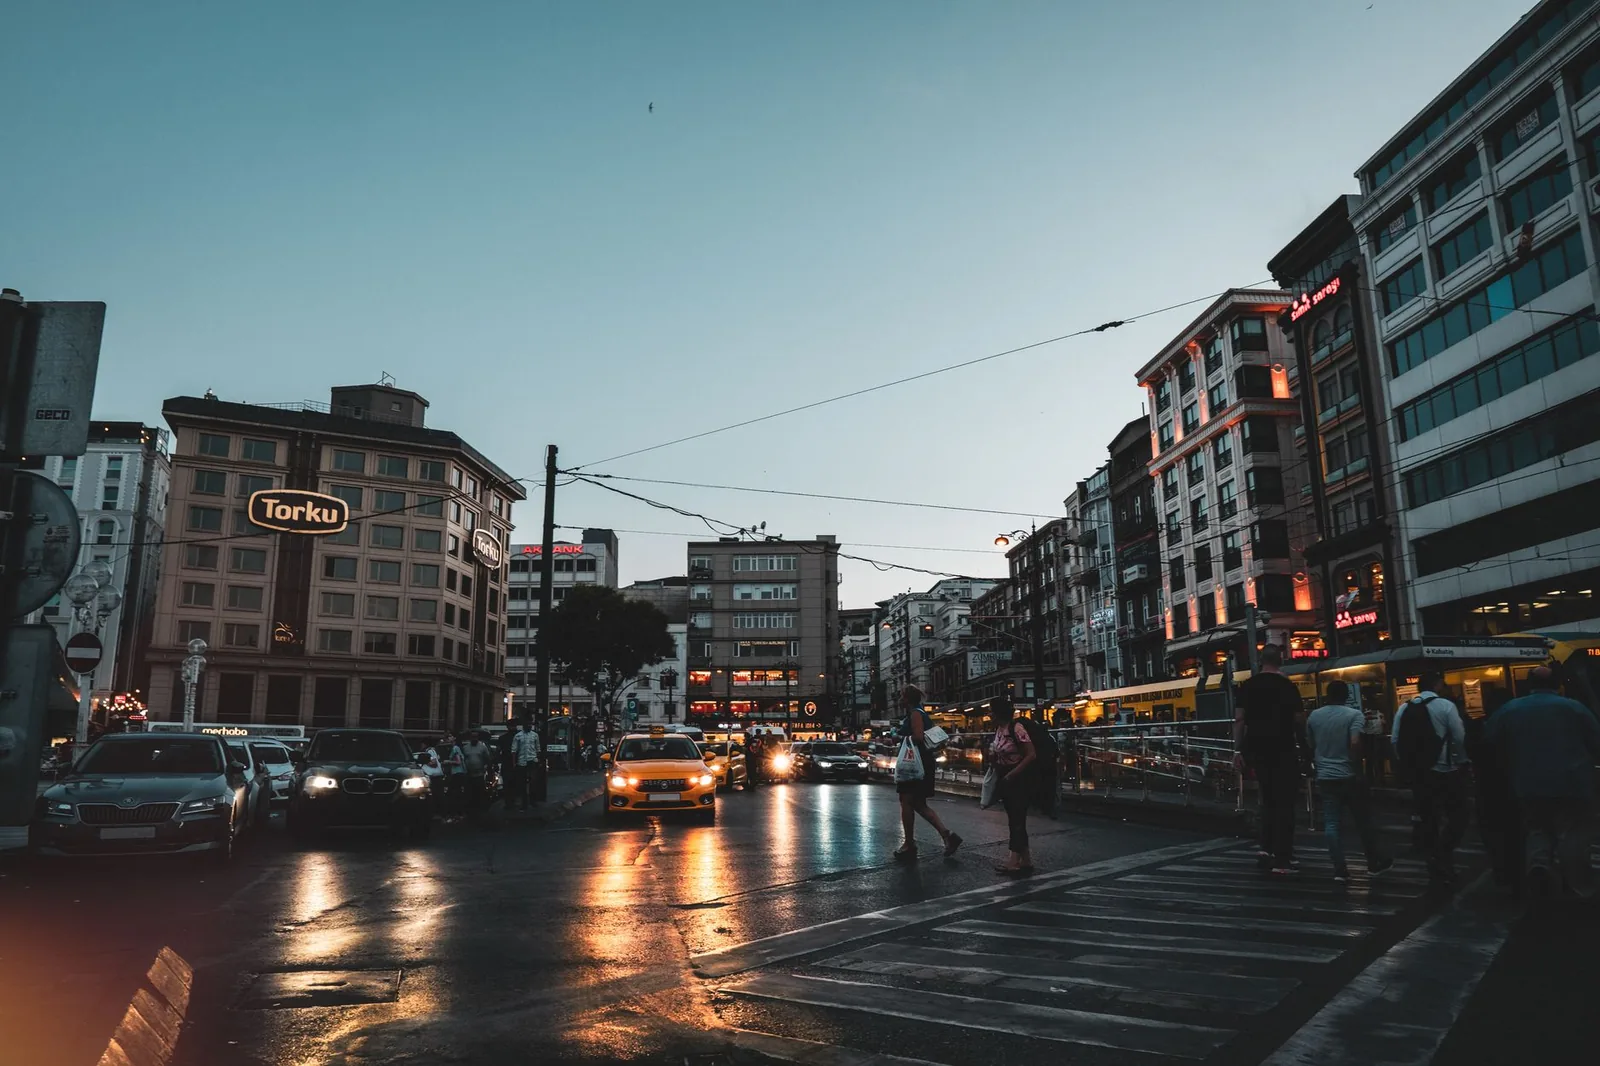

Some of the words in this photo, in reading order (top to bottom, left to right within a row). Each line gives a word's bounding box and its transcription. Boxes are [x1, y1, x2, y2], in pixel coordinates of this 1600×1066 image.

[261, 498, 338, 523] Torku
[476, 536, 499, 562] Torku
[523, 545, 584, 553] AKANK
[202, 727, 248, 736] merhaba
